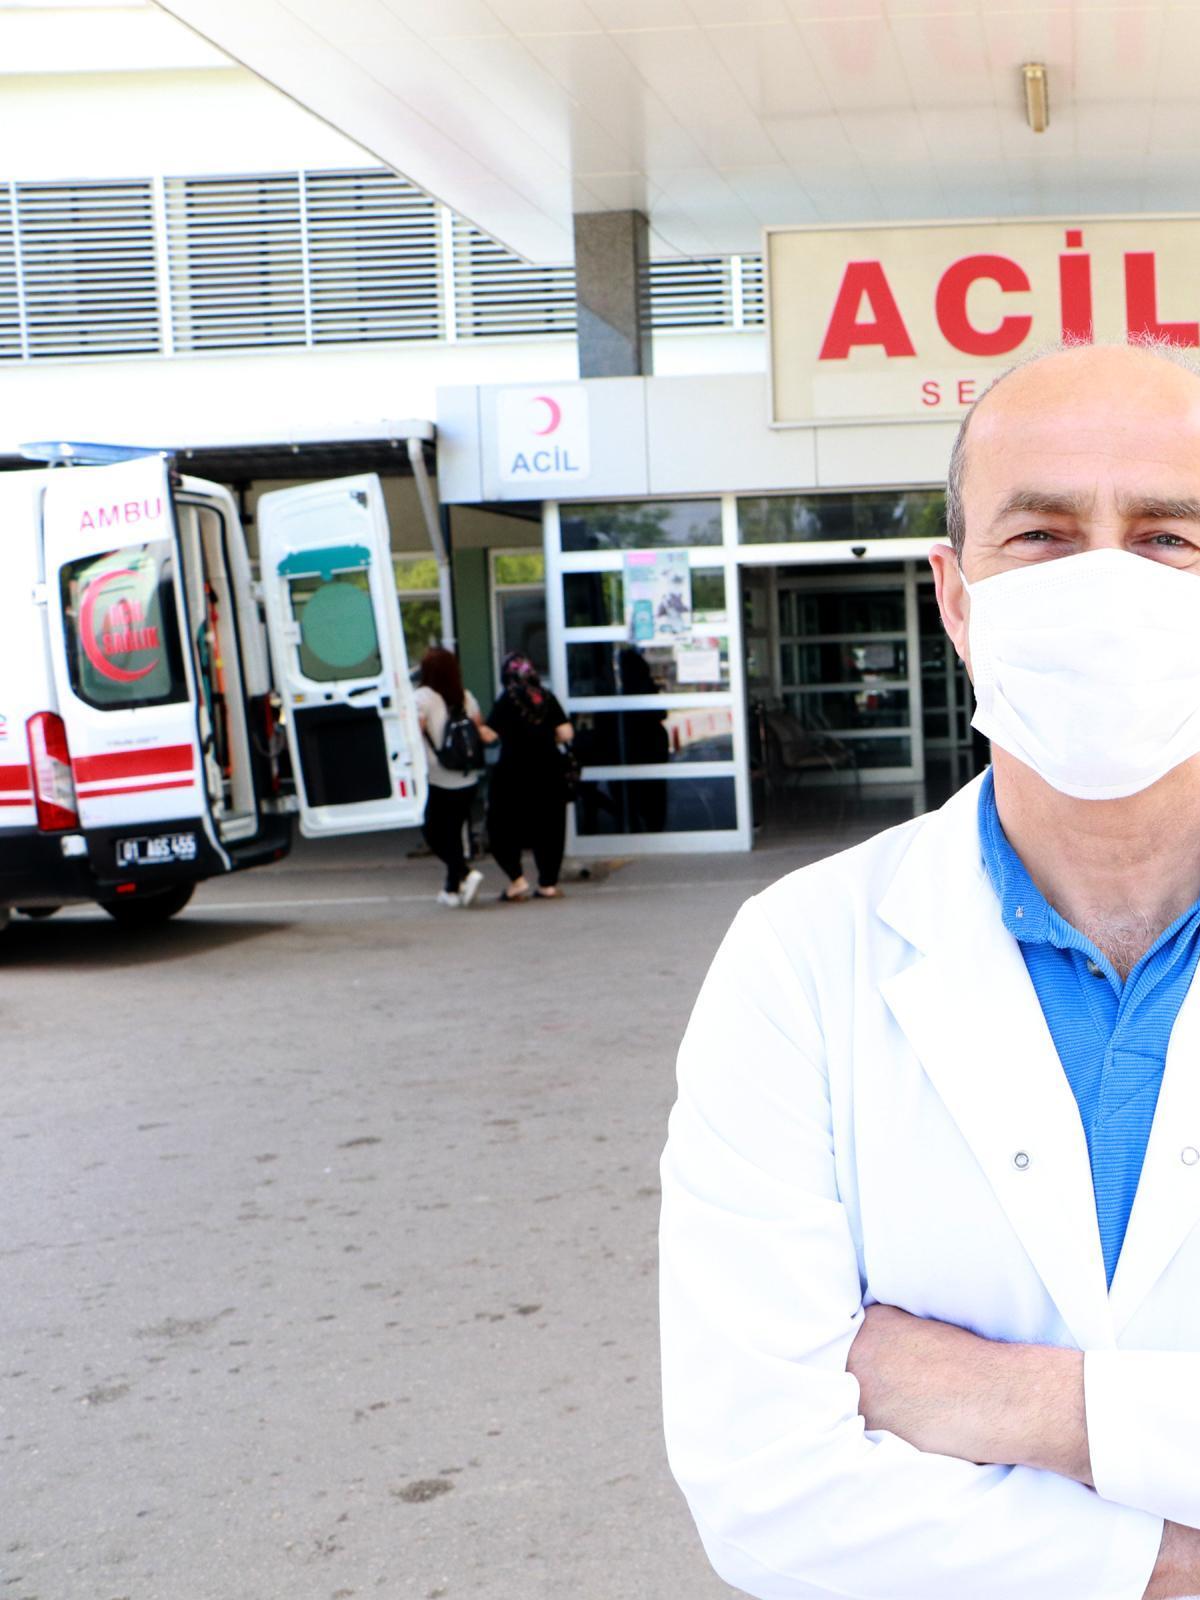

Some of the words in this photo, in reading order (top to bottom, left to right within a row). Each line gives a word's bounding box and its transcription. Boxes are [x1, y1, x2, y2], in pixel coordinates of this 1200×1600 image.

[818, 230, 1200, 360] ACİL
[511, 445, 580, 474] ACİL
[79, 497, 162, 532] AMBU
